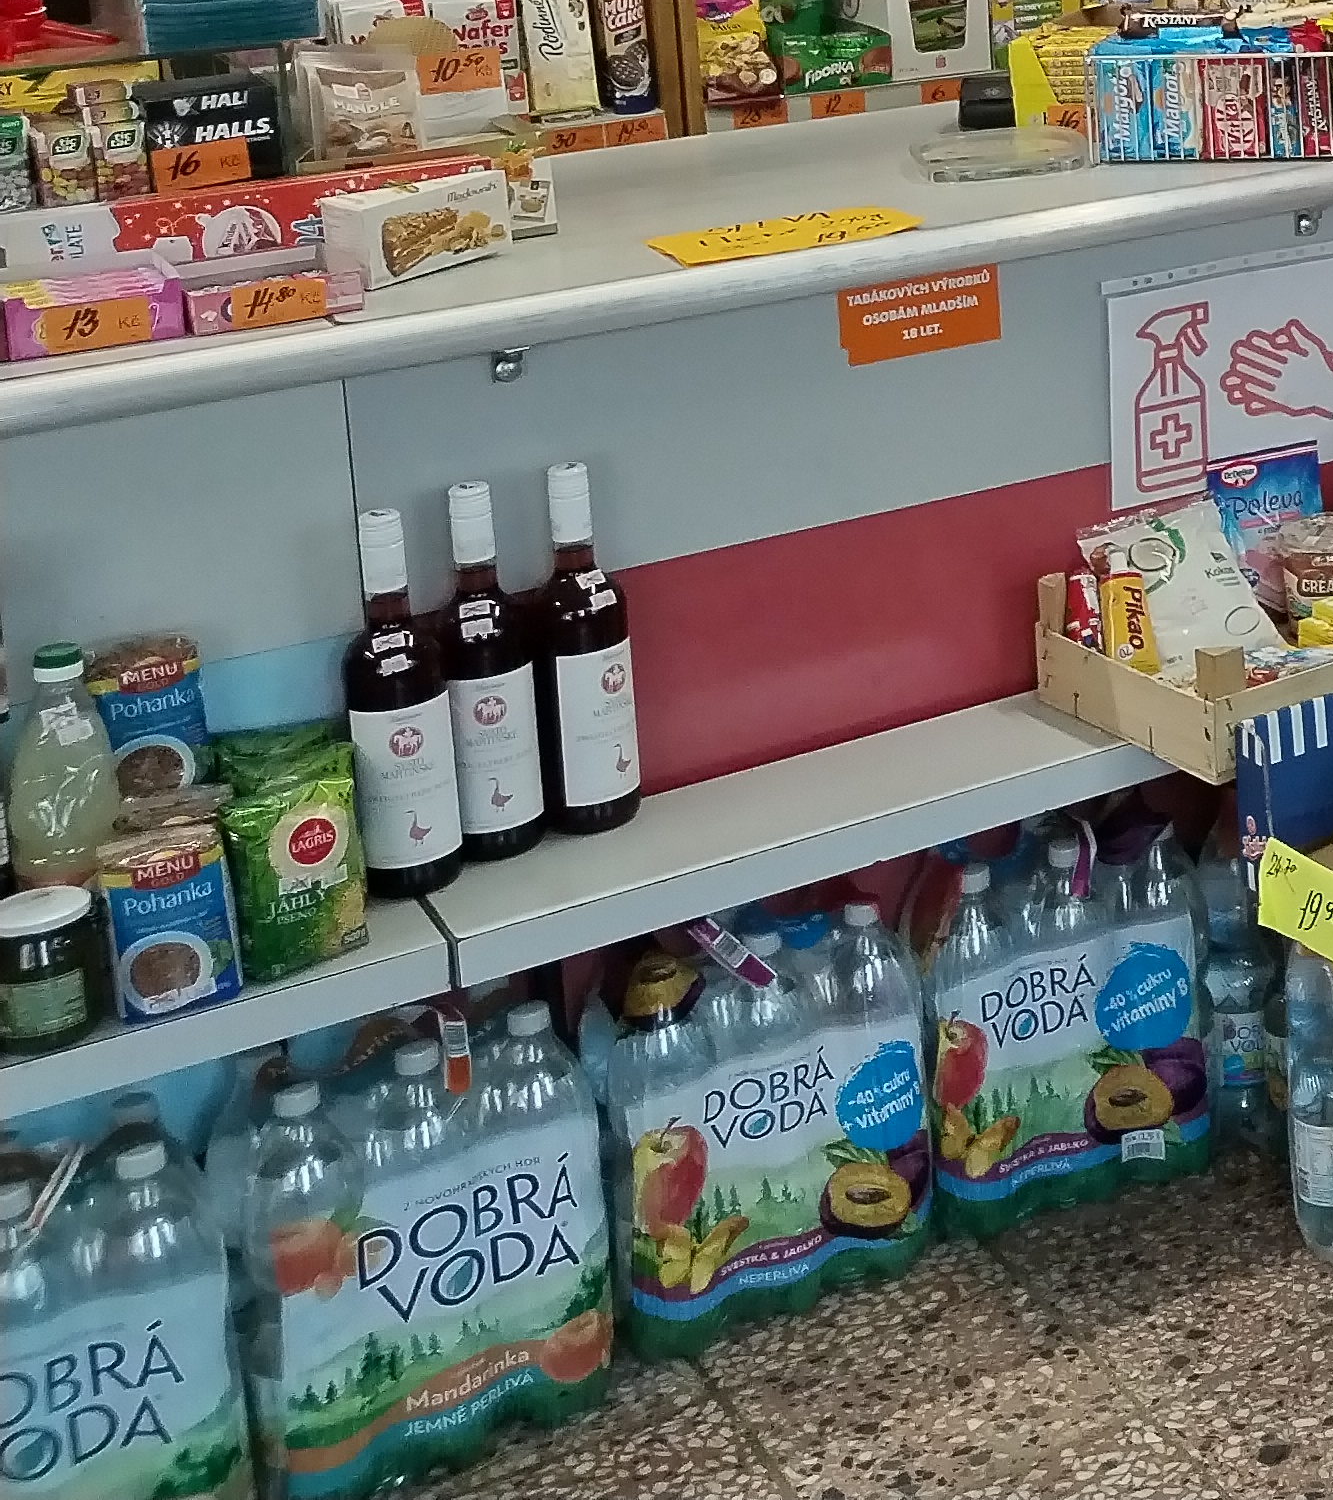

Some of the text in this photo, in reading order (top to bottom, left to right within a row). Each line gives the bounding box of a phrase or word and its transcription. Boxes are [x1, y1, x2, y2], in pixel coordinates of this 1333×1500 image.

[847, 269, 991, 307] TABÁKOVÝCH VÝROBKŮ
[63, 308, 100, 340] 13
[862, 294, 979, 326] OSOBÁM MLADŠÍM
[901, 327, 918, 340] 18
[1230, 490, 1305, 521] Poleva
[1204, 564, 1236, 579] Kokos
[1122, 586, 1147, 650] Pikao
[109, 686, 196, 722] Pohanka
[137, 856, 195, 882] MENU
[122, 880, 214, 917] Pohanka
[981, 953, 1096, 1024] DOBRÁ
[1136, 968, 1173, 996] cukru
[990, 993, 1089, 1049] VODA
[703, 1045, 835, 1125] DOBRÁ
[711, 1091, 828, 1149] VODA
[357, 1152, 579, 1291] DOBRÁ
[377, 1227, 581, 1323] VODA
[404, 1346, 532, 1414] Mandarinka
